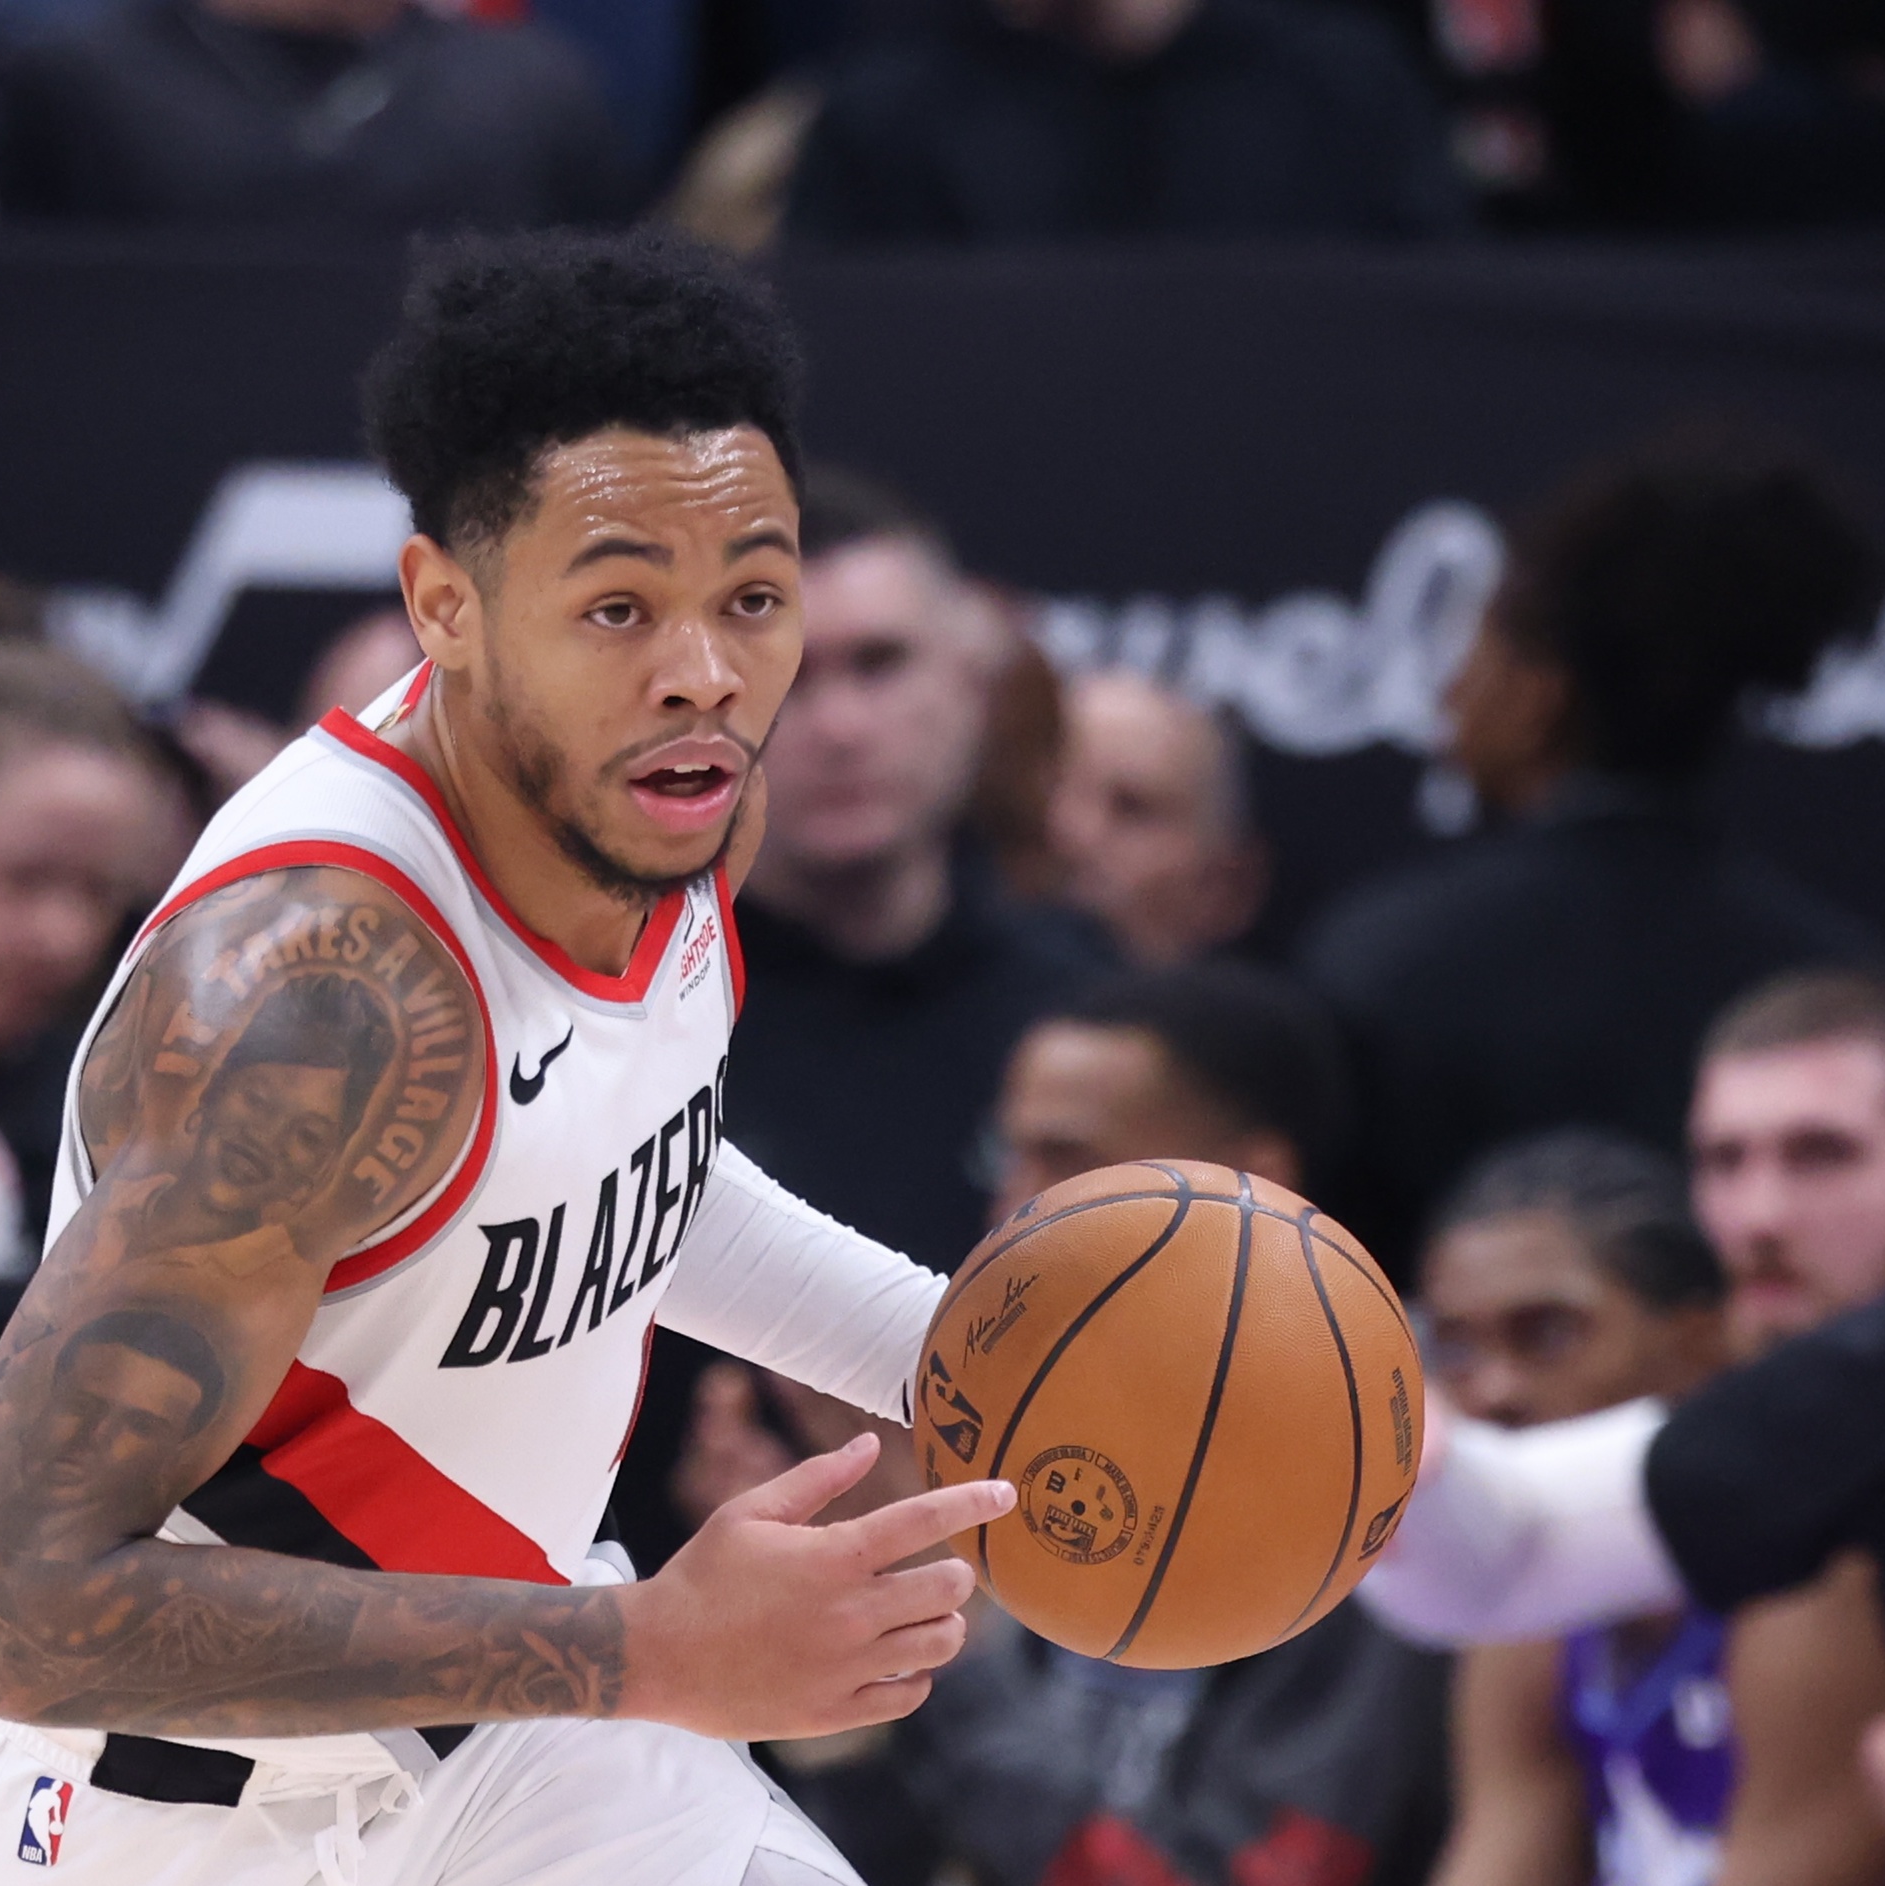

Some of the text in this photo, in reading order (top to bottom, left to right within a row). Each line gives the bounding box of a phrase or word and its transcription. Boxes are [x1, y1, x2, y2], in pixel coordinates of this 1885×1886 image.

[198, 906, 382, 1000] TAKES
[372, 932, 421, 982] A
[679, 914, 718, 984] GHTSIDE
[352, 967, 464, 1206] VILLAGE
[21, 1844, 43, 1863] NBA
